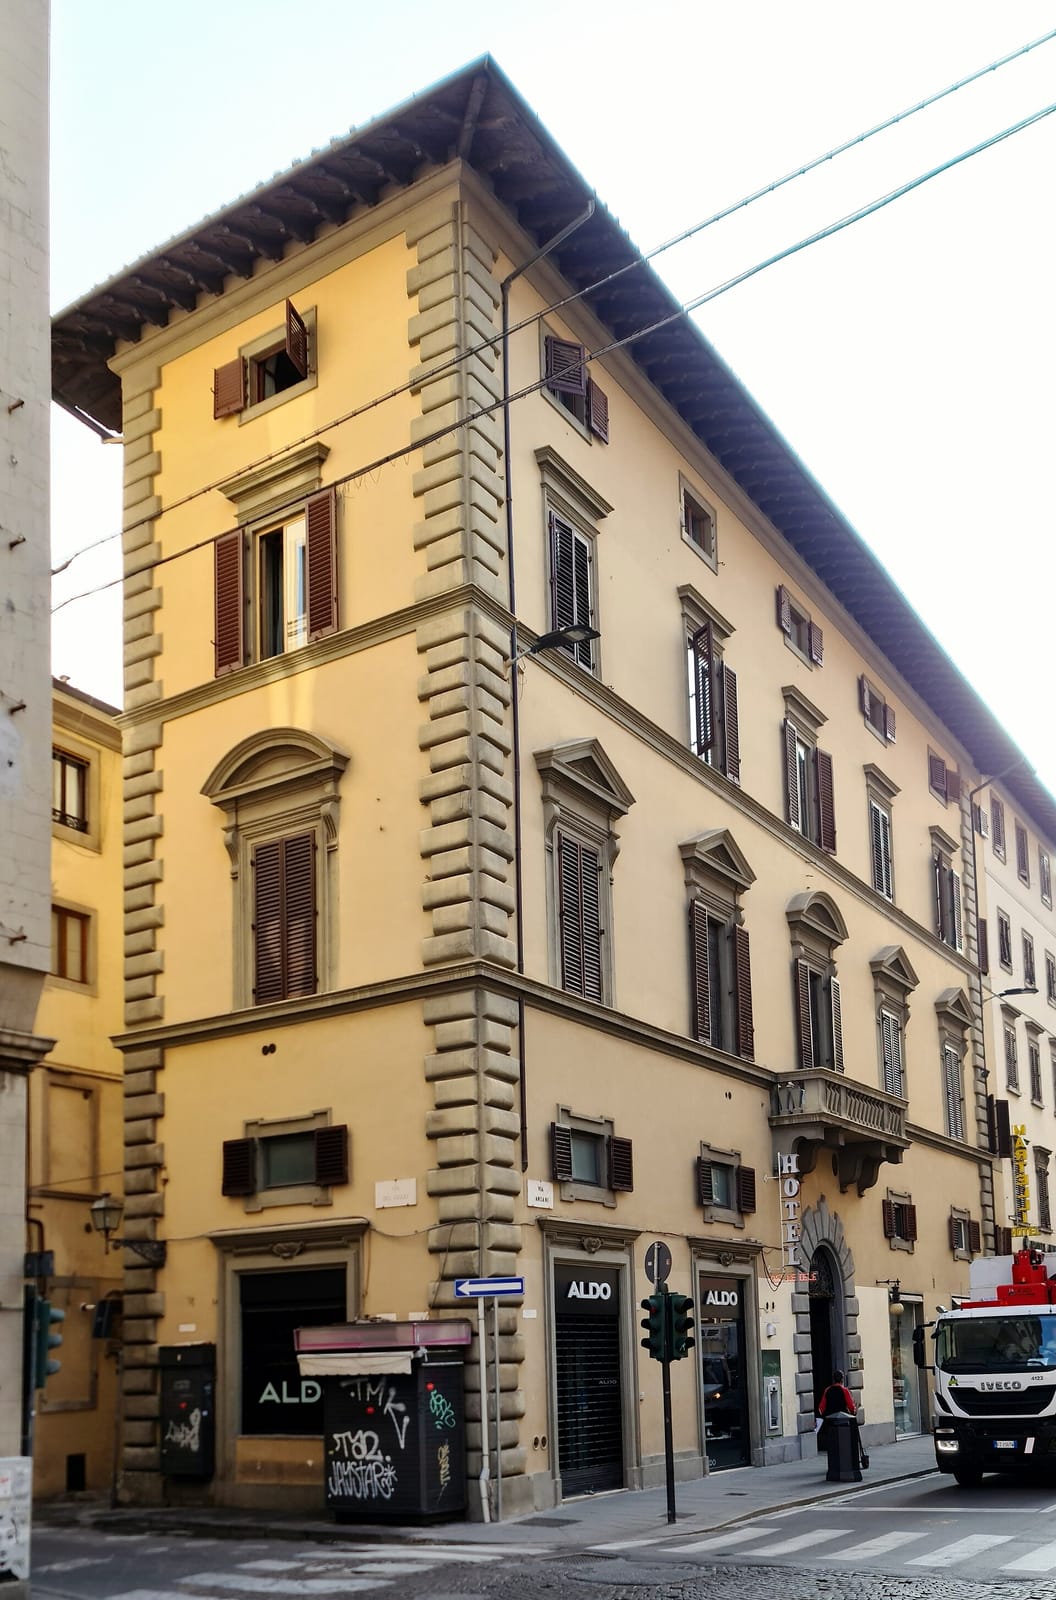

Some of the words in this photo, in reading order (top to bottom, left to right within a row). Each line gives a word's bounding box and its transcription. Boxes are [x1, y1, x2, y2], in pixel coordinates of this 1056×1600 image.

[781, 1153, 801, 1266] HOTEL
[567, 1280, 612, 1301] ALDO
[705, 1290, 738, 1306] ALDO
[258, 1380, 322, 1404] ALD
[980, 1381, 1022, 1391] IVECO
